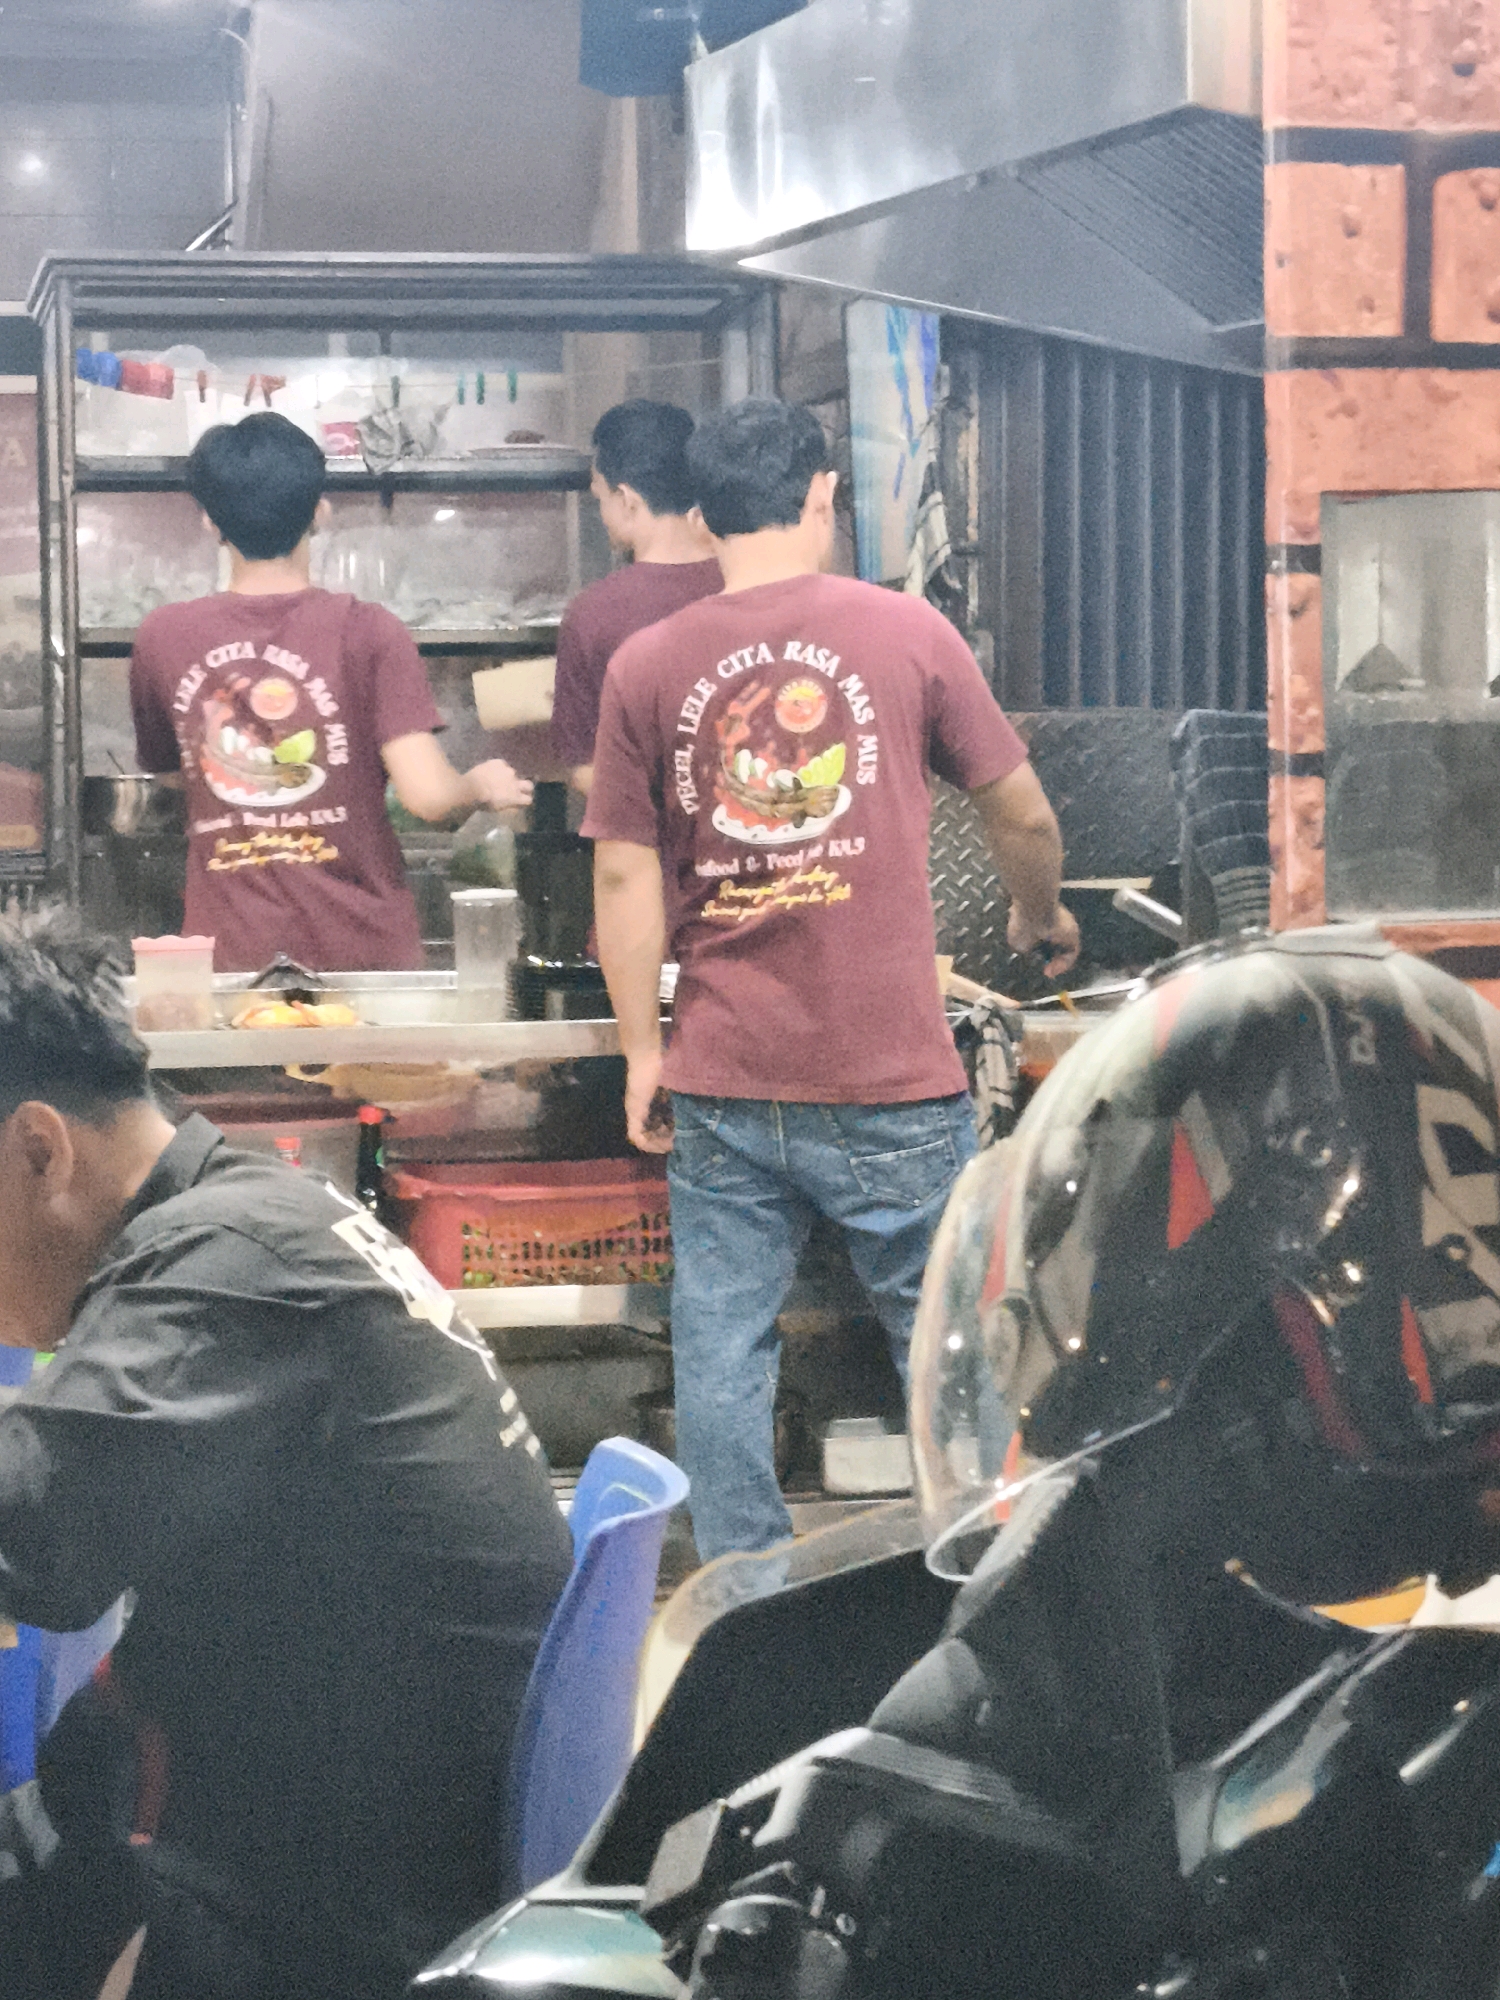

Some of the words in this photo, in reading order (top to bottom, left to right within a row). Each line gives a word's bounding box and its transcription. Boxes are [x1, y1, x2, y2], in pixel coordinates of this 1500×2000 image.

[205, 641, 257, 668] CITA
[716, 642, 775, 679] CITA
[783, 640, 841, 678] RASA
[677, 677, 718, 735] LELE
[837, 673, 876, 725] MAS
[856, 734, 879, 786] MUS
